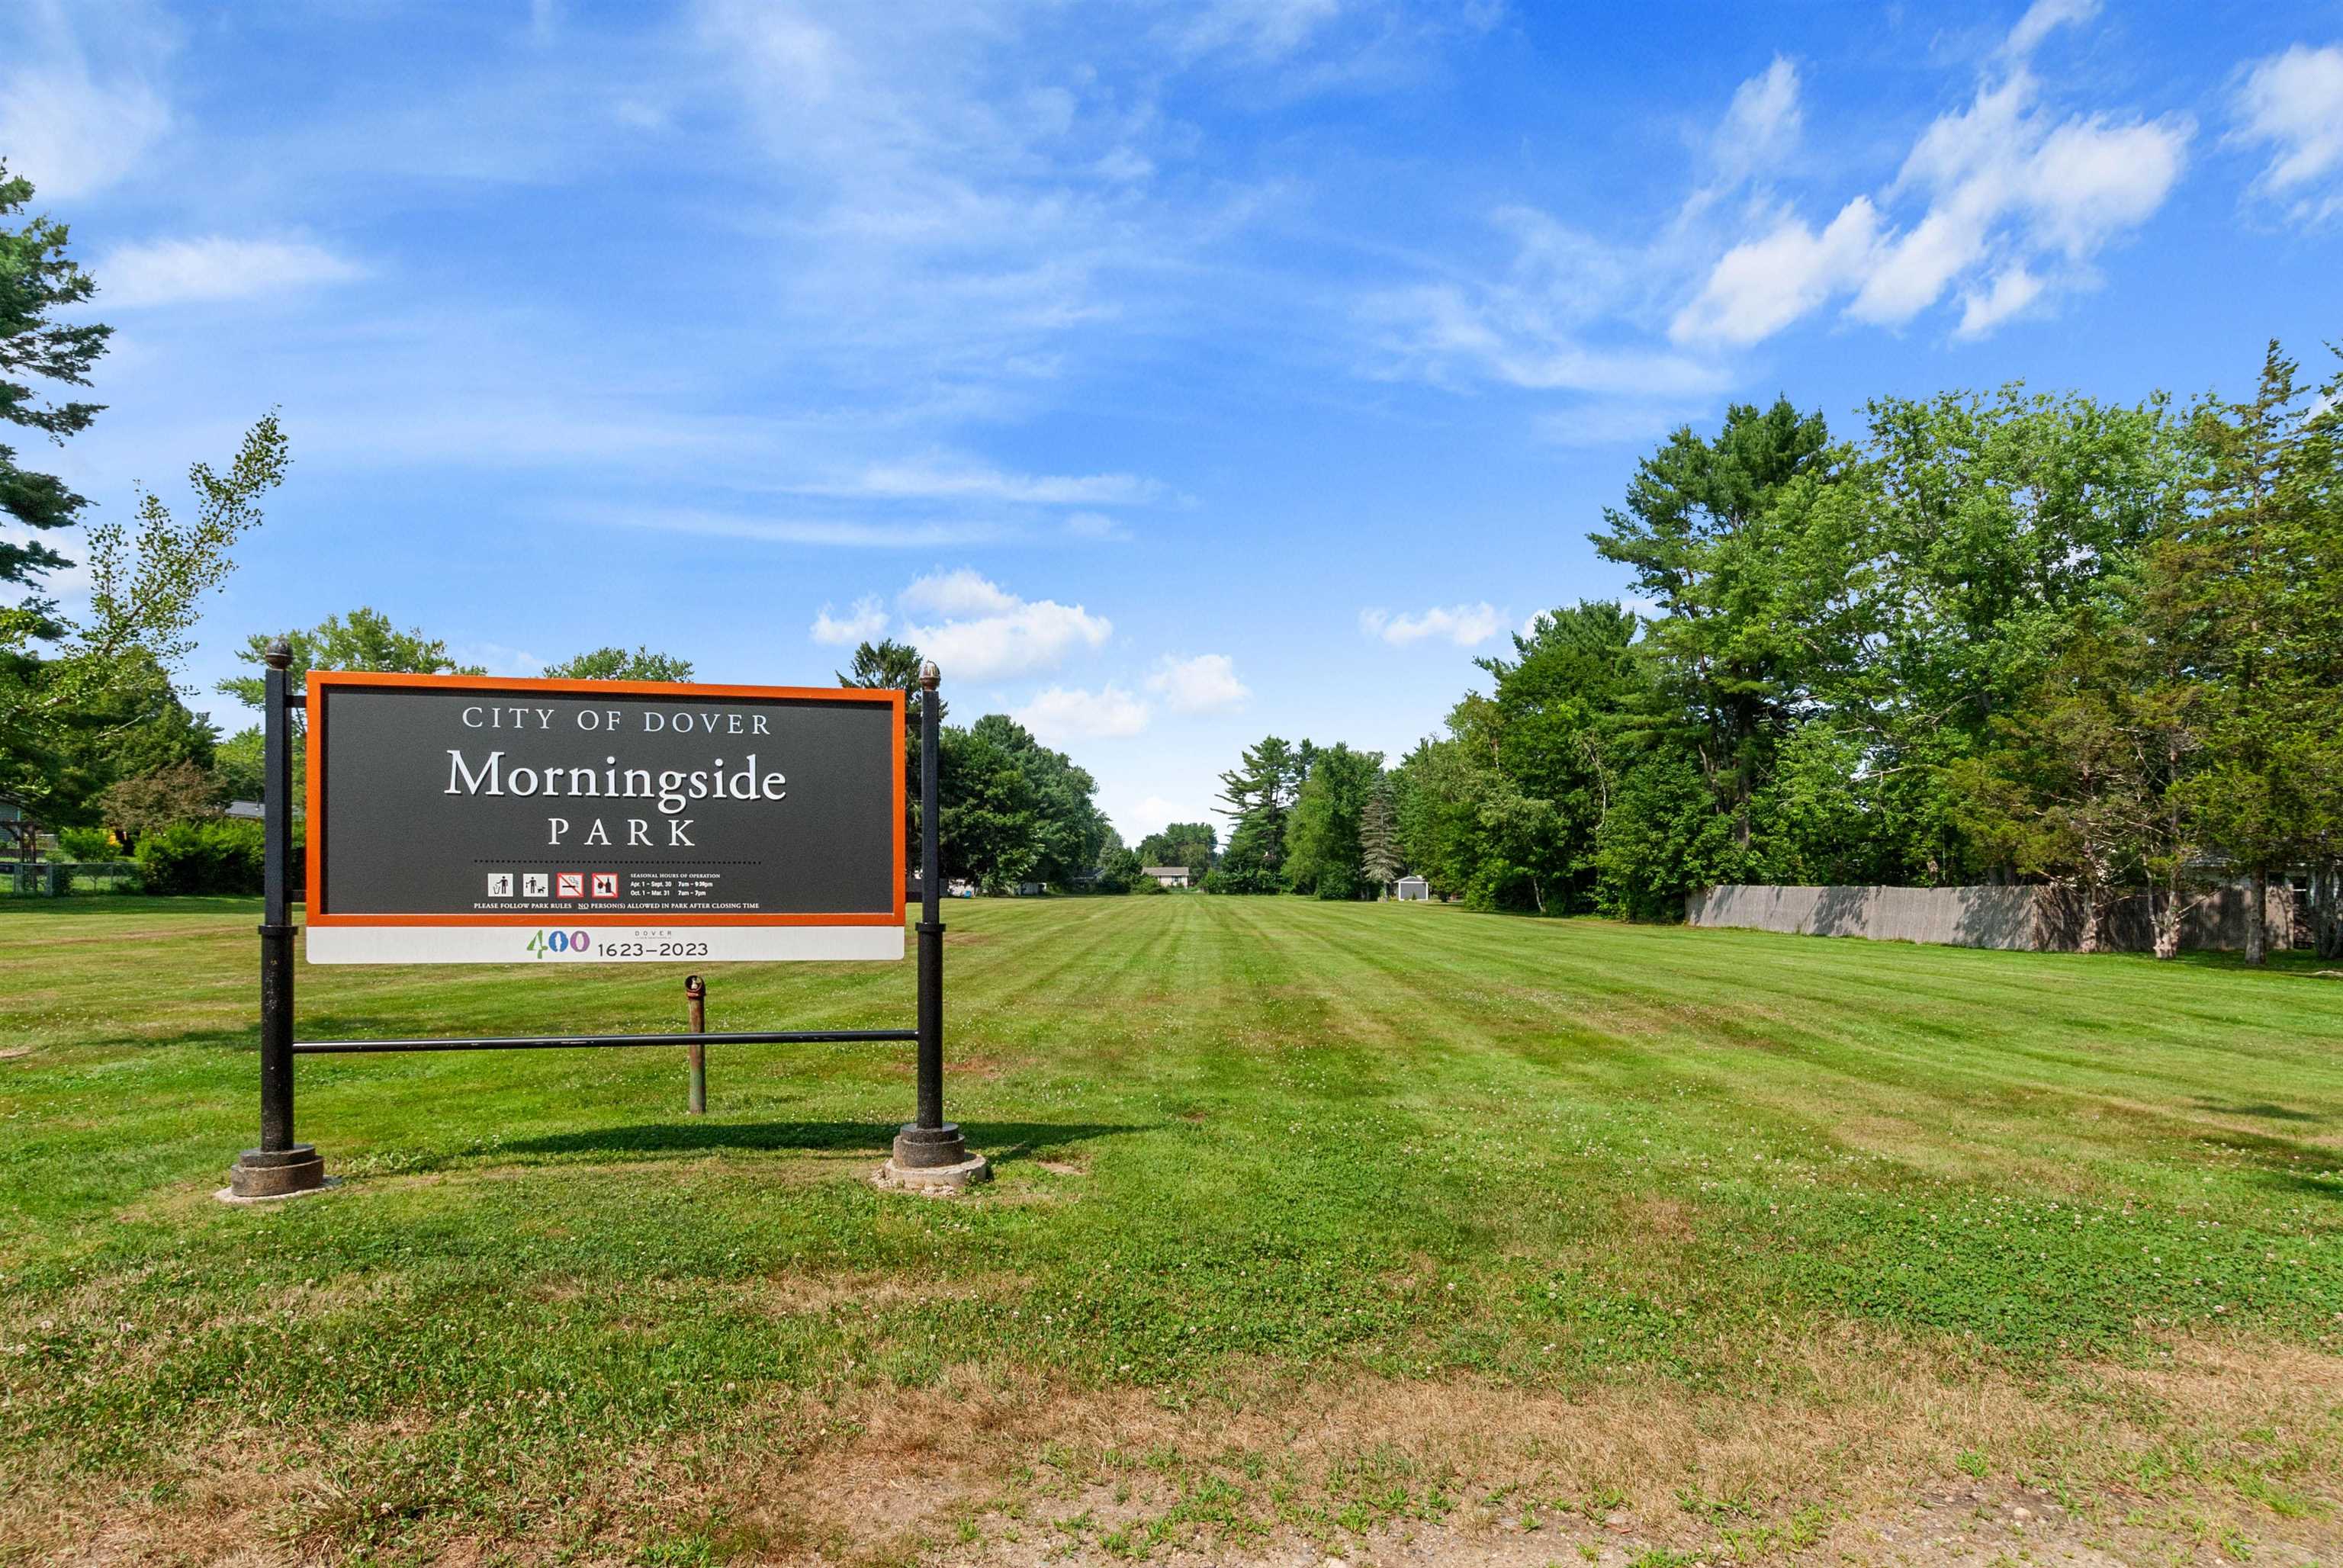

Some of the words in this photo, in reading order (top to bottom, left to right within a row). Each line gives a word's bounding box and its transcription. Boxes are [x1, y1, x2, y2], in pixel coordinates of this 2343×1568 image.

[462, 707, 555, 729] CITY
[577, 710, 622, 731] OF
[644, 712, 771, 735] DOVER
[443, 750, 787, 815] Morningside
[548, 818, 696, 847] PARK
[526, 930, 590, 959] 400
